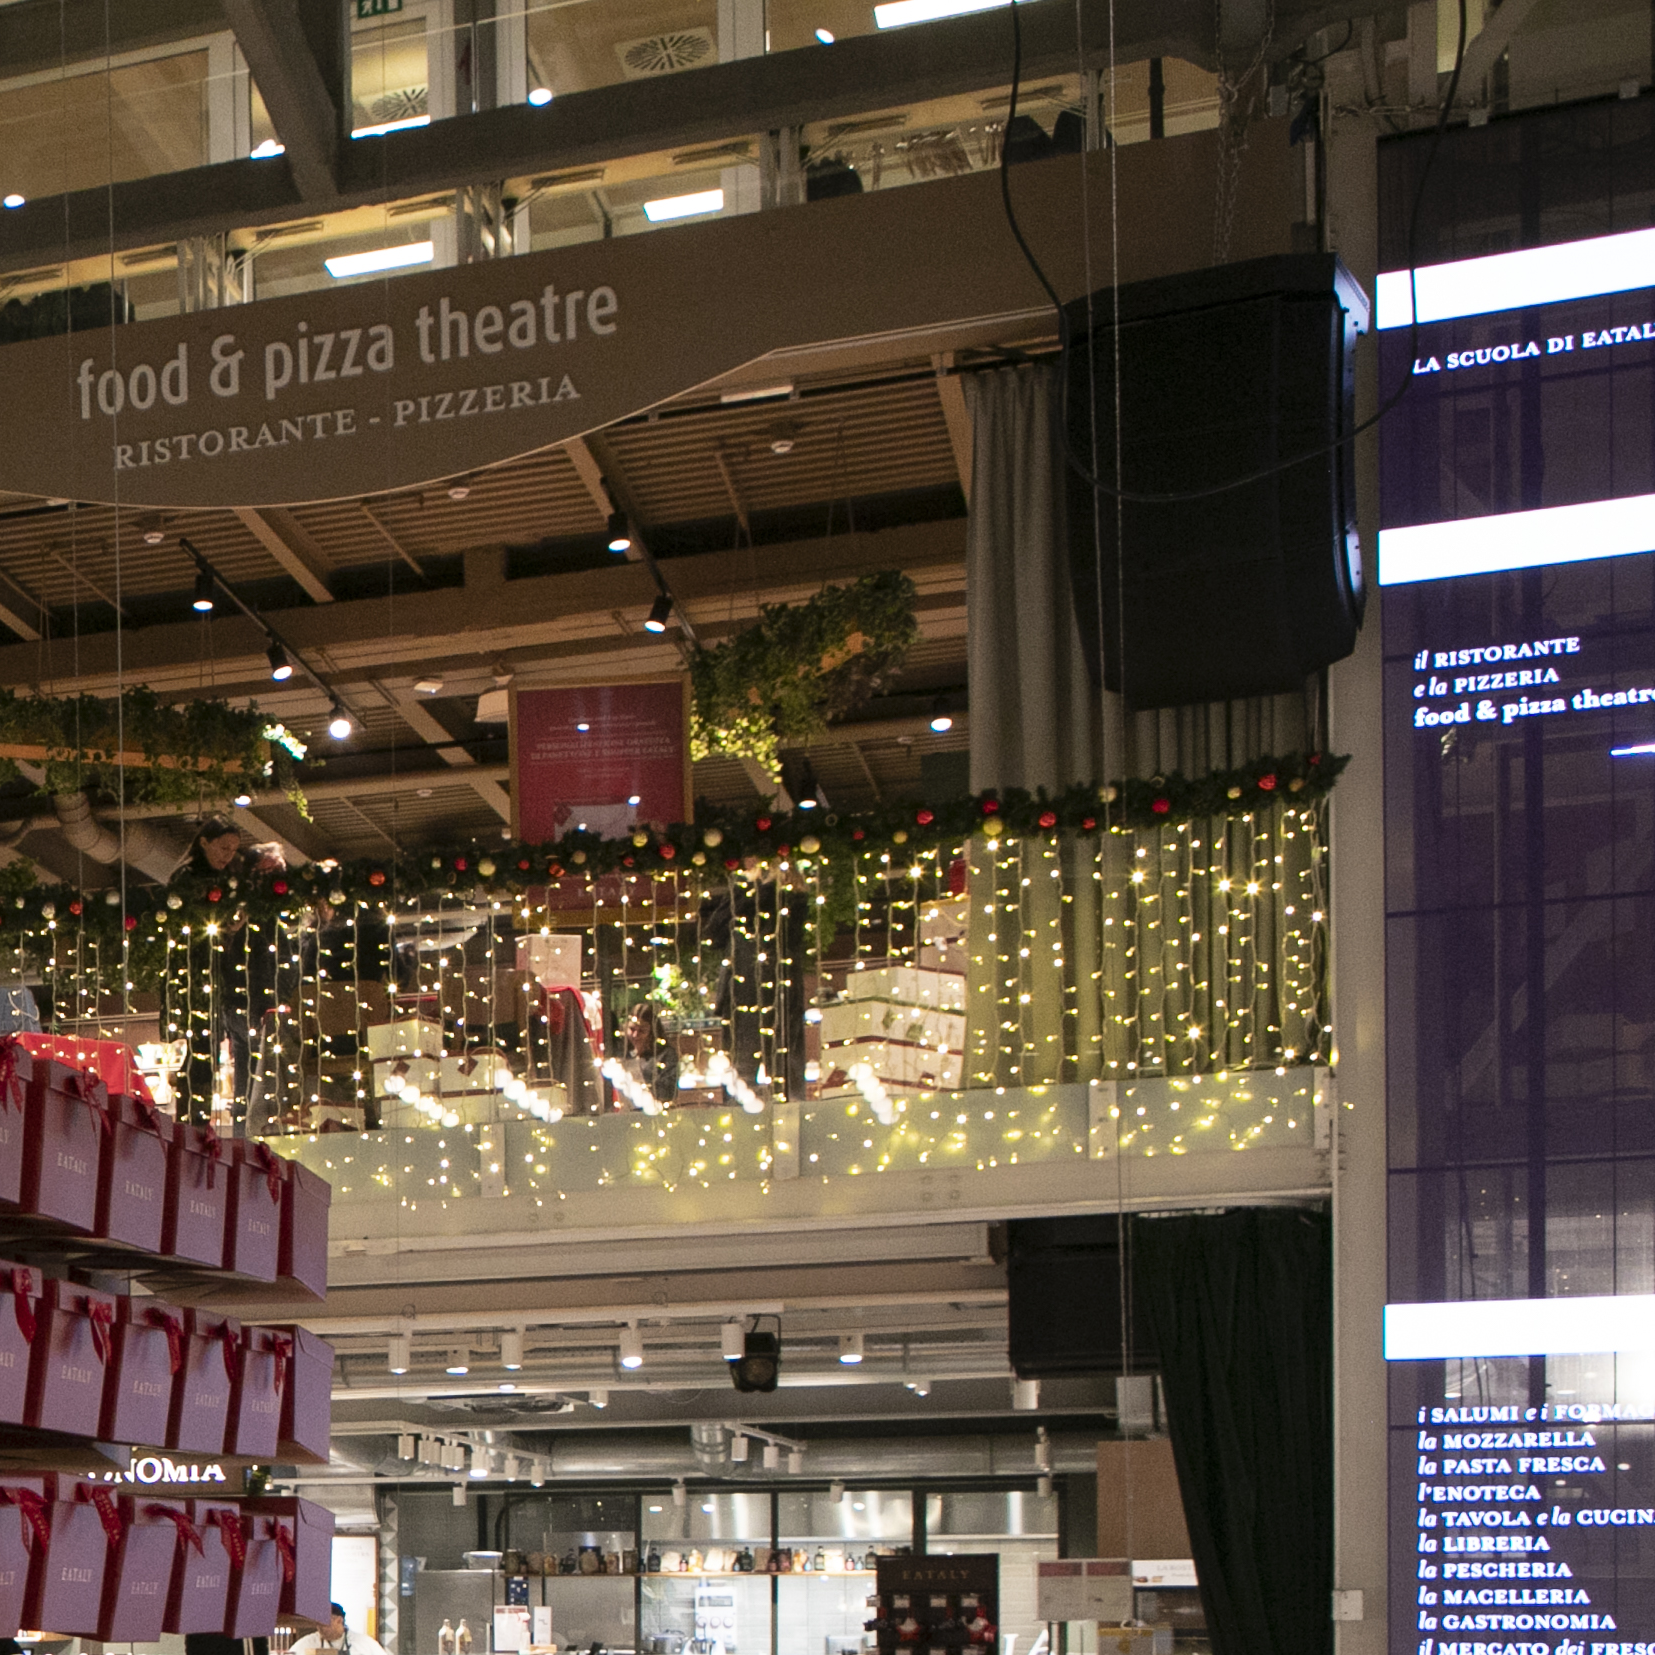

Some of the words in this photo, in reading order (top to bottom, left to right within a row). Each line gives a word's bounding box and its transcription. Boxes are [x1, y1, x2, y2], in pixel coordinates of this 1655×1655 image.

[76, 342, 189, 420] food
[210, 334, 244, 397] &
[265, 321, 392, 399] pizza
[416, 284, 618, 364] theatre
[1413, 356, 1441, 374] LA
[1447, 341, 1540, 369] SCUOLA
[1547, 335, 1574, 354] DI
[1582, 323, 1655, 348] EATAL
[114, 408, 357, 470] RISTORANTE
[393, 373, 582, 427] PIZZERIA
[1414, 650, 1429, 670] il
[1434, 637, 1580, 668] RISTORANTE
[1413, 684, 1425, 698] e
[1428, 676, 1448, 696] la
[1453, 667, 1560, 694] PIZZERIA
[1414, 702, 1470, 728] food
[1475, 700, 1497, 721] &
[1501, 696, 1567, 725] pizza
[1417, 1406, 1426, 1424] i
[1430, 1405, 1519, 1424] SALUMI
[1524, 1408, 1537, 1423] e
[1540, 1403, 1548, 1422] i
[1417, 1430, 1437, 1451] la
[1442, 1431, 1596, 1450] MOZZARELLA
[1417, 1455, 1437, 1476] la
[1442, 1458, 1513, 1475] PASTA
[1518, 1456, 1607, 1474] FRESCA
[1417, 1482, 1542, 1503] l'ENOTECA
[1417, 1507, 1437, 1528] la
[1441, 1510, 1532, 1528] TAVOLA
[1535, 1513, 1548, 1527] e
[1551, 1505, 1571, 1526] la
[1576, 1508, 1655, 1526] CUCIN
[1417, 1532, 1437, 1553] la
[1442, 1535, 1551, 1553] LIBRERIA
[903, 1569, 970, 1580] EATALY
[1417, 1559, 1437, 1580] la
[1442, 1562, 1573, 1580] PESCHERIA
[1417, 1585, 1437, 1606] la
[1442, 1589, 1591, 1606] MACELLERIA
[1417, 1610, 1437, 1631] la
[1442, 1613, 1617, 1631] GASTRONOMIA
